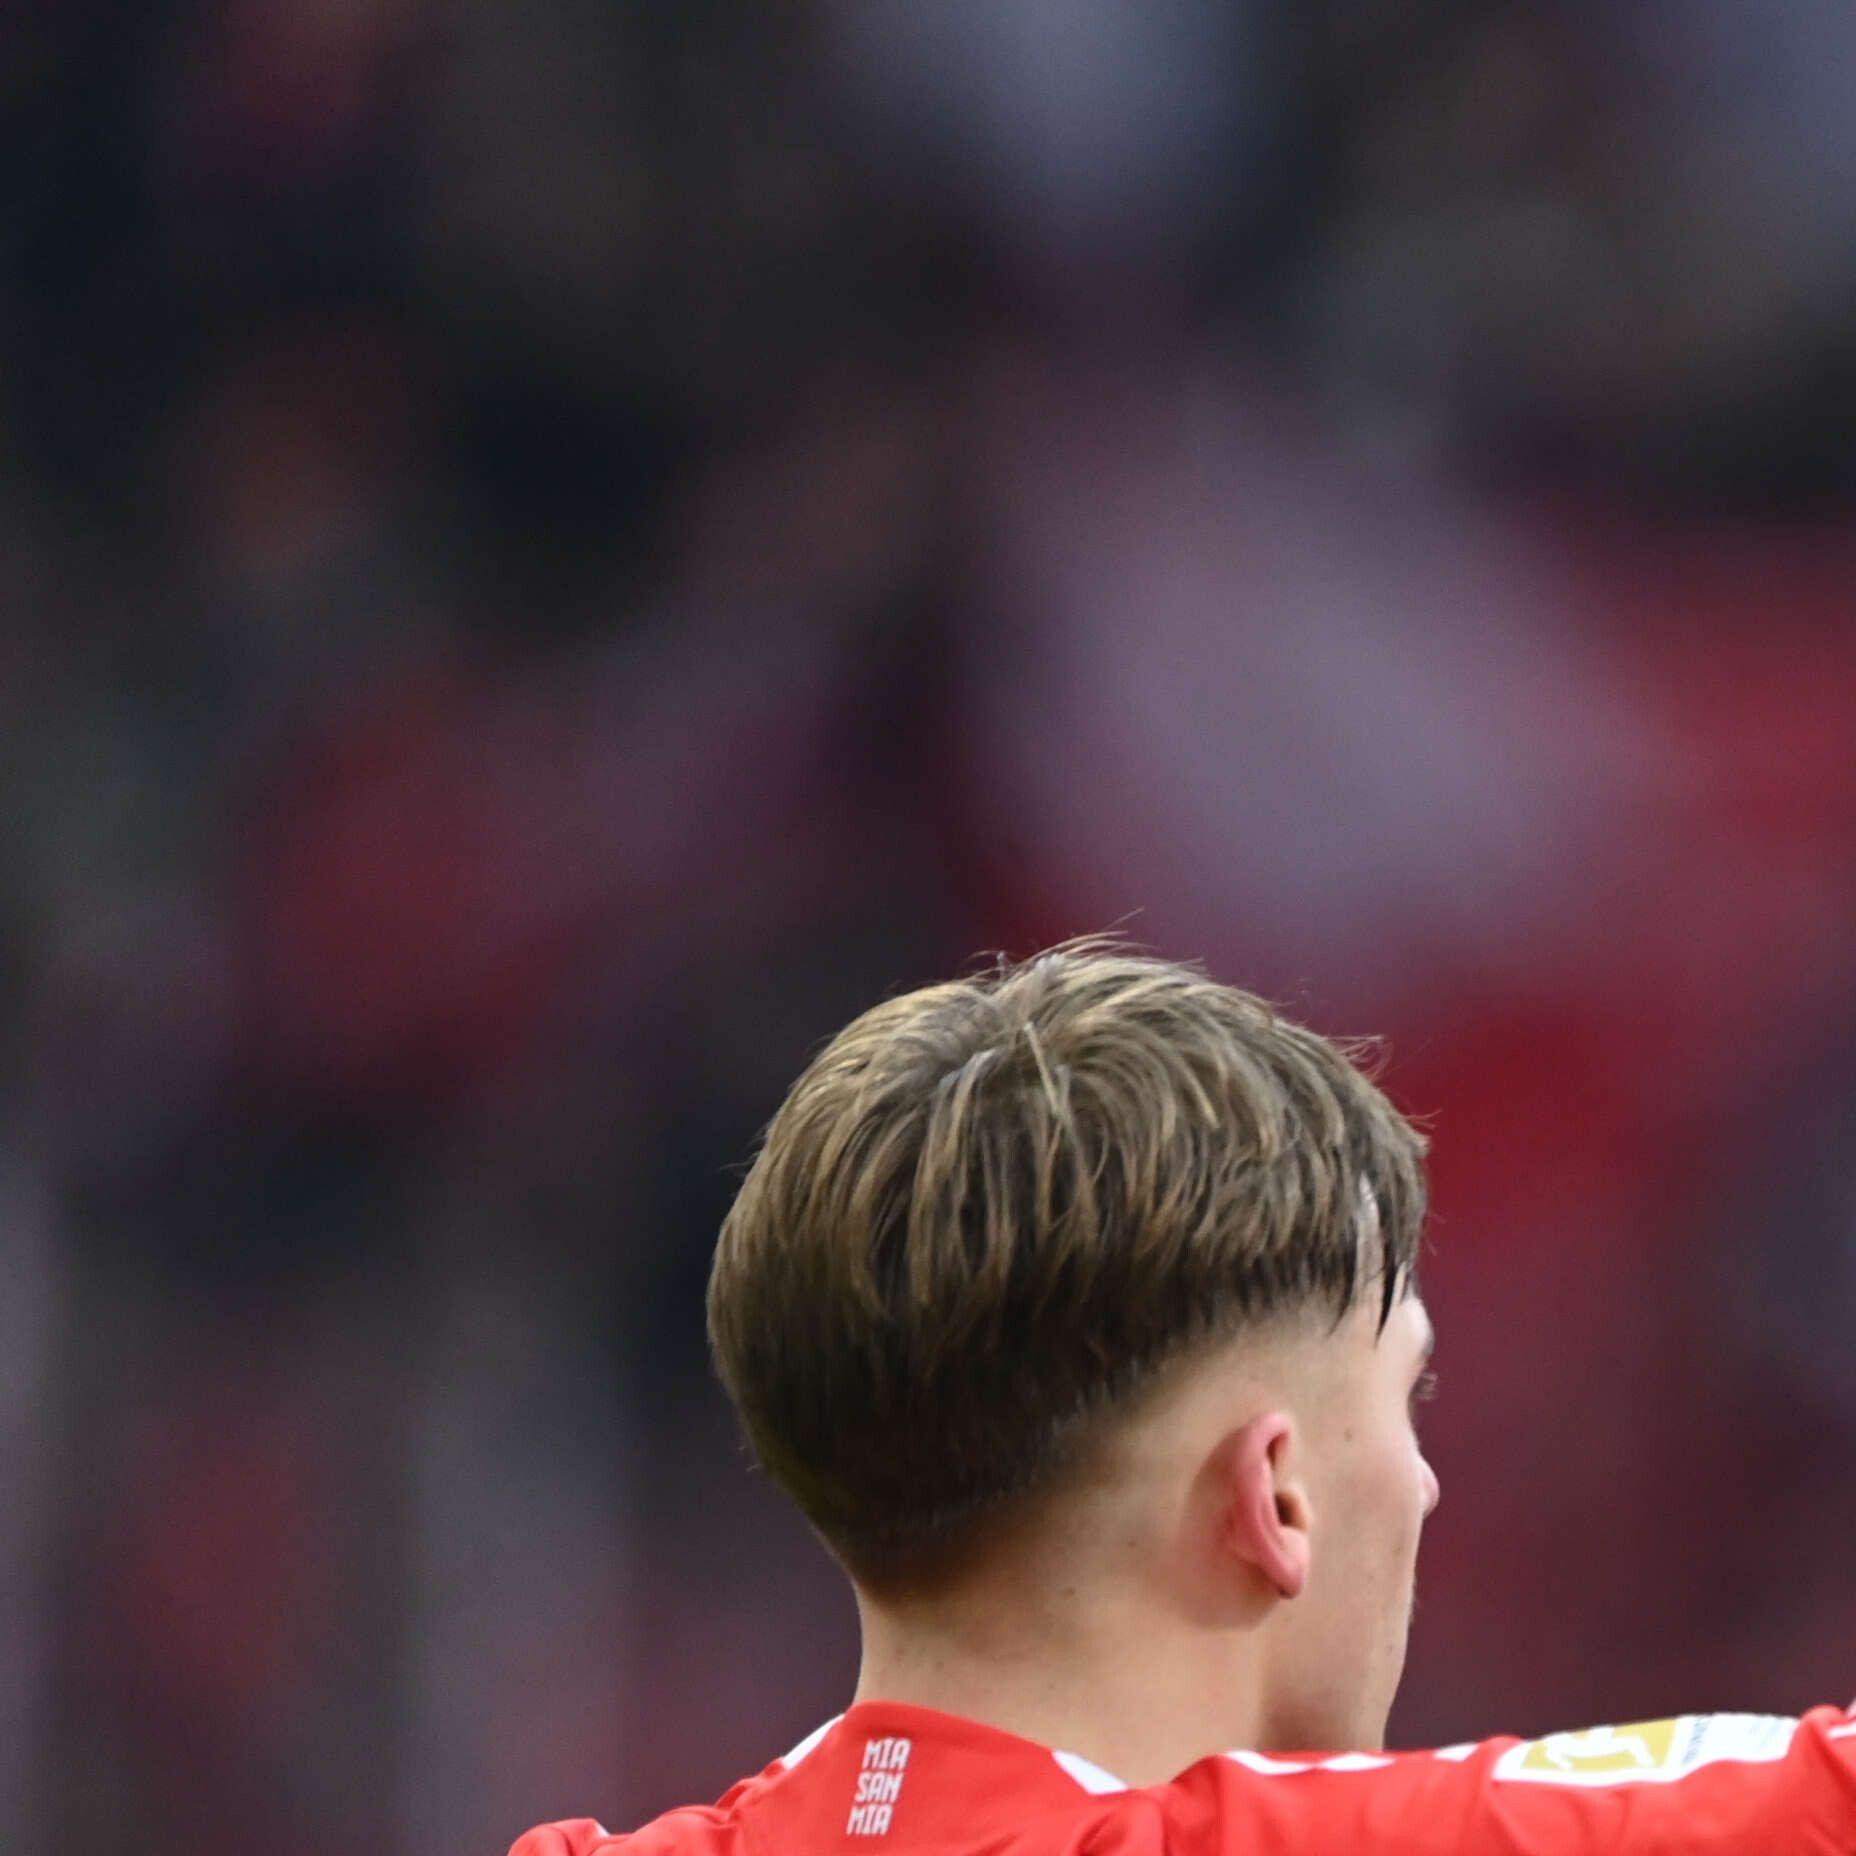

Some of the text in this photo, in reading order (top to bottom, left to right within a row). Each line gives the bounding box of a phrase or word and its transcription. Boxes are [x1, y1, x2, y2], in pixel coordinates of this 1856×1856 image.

[862, 1737, 911, 1770] MIA
[854, 1770, 904, 1803] SAN
[846, 1803, 893, 1836] MIA
